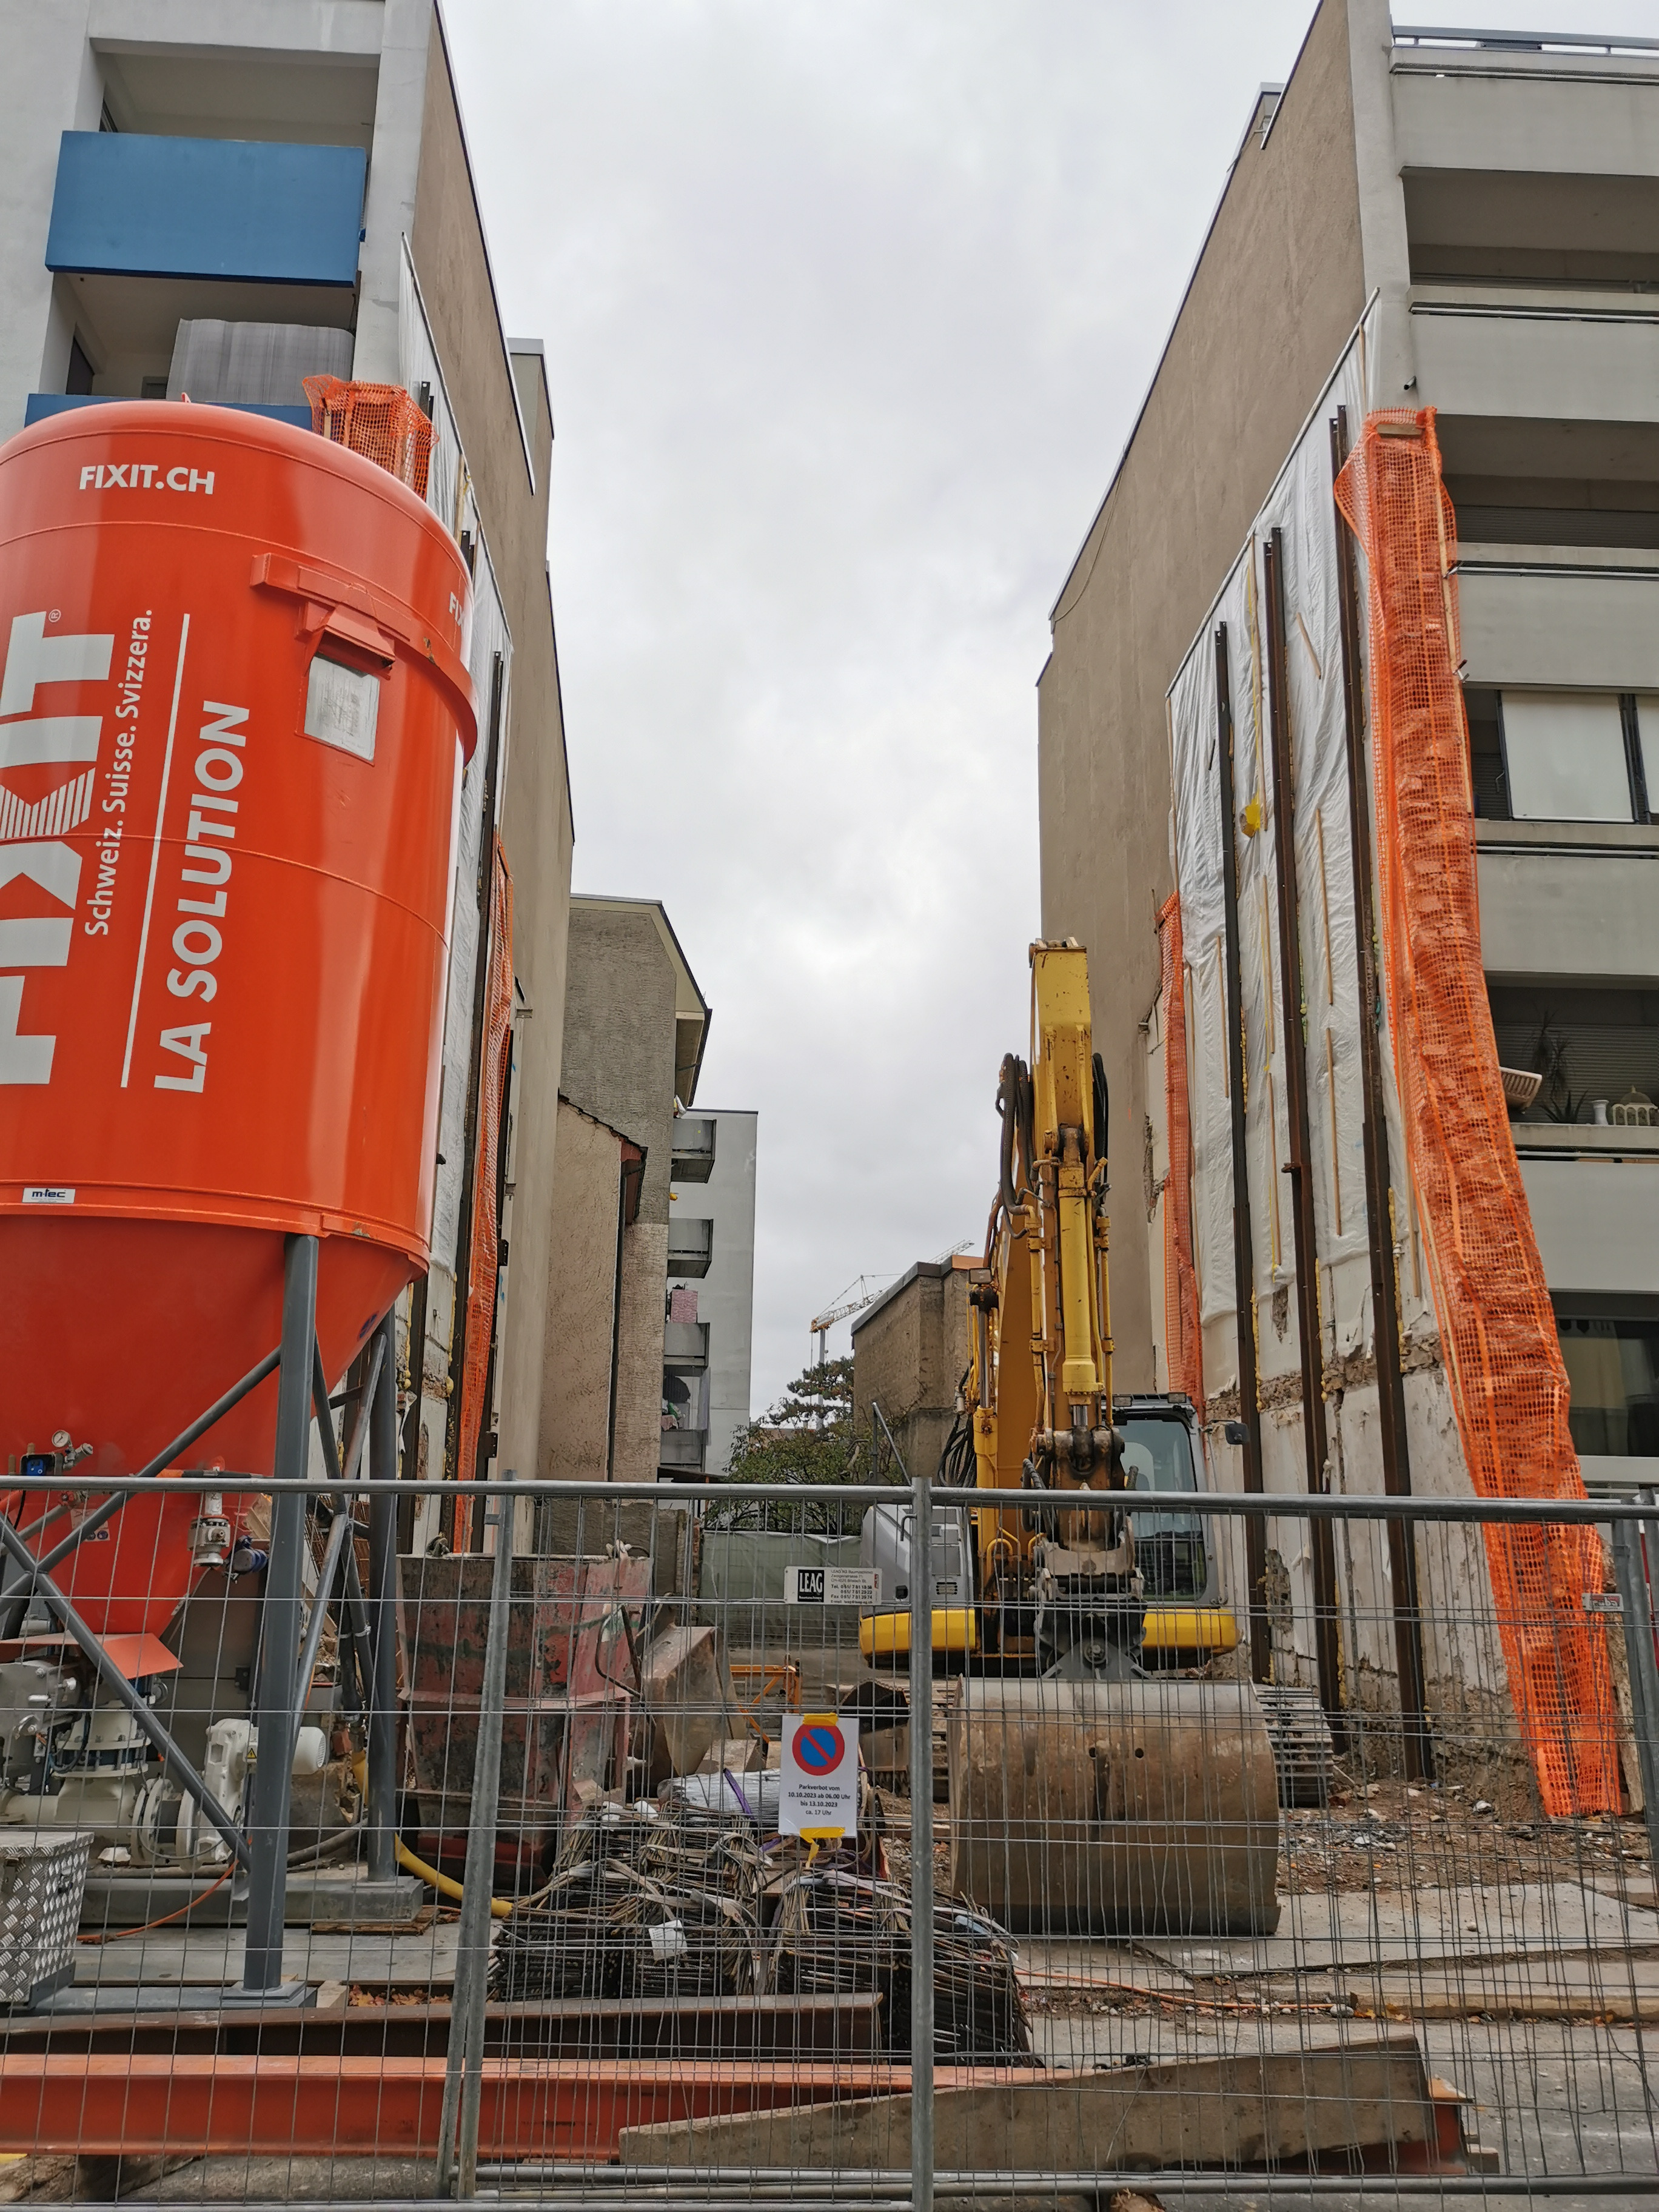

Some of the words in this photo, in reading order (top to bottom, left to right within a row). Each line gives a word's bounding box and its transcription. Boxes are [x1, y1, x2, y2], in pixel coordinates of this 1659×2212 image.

[79, 464, 215, 495] FIXIT.CH
[115, 609, 152, 719] Svizzera.
[102, 725, 136, 813] Suisse.
[84, 820, 123, 936] Schweiz.
[166, 700, 250, 1003] SOLUTION
[153, 1022, 212, 1093] LA
[799, 1572, 823, 1593] LEAG
